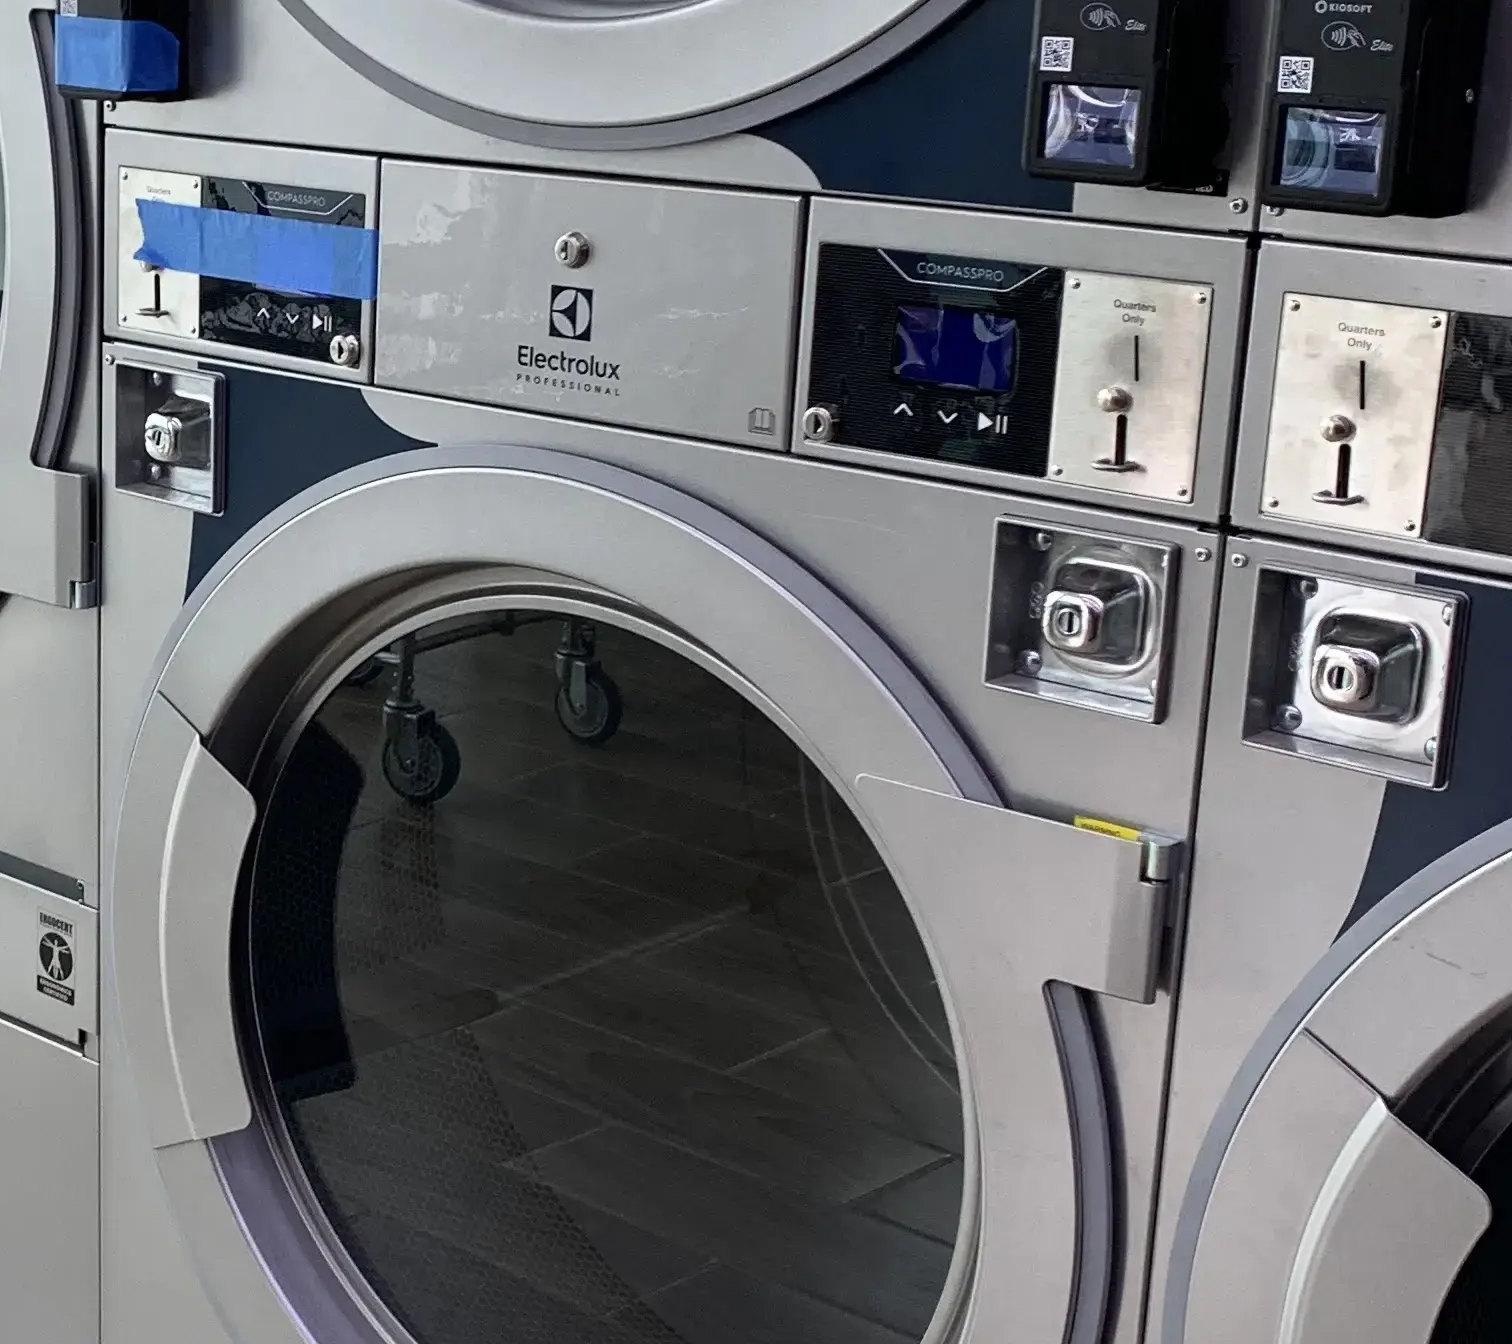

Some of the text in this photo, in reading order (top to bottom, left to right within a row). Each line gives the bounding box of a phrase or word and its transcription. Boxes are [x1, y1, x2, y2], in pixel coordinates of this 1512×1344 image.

[1329, 2, 1373, 14] KIOSOFT
[266, 190, 326, 207] COMPASSPRO
[916, 261, 1005, 283] COMPASSPRO
[1113, 298, 1157, 313] Quarters
[1121, 313, 1145, 327] Only
[1338, 321, 1386, 338] Quarters
[1347, 337, 1373, 352] Only
[517, 345, 621, 381] Electrolux
[516, 373, 621, 397] PROFESSIONAL
